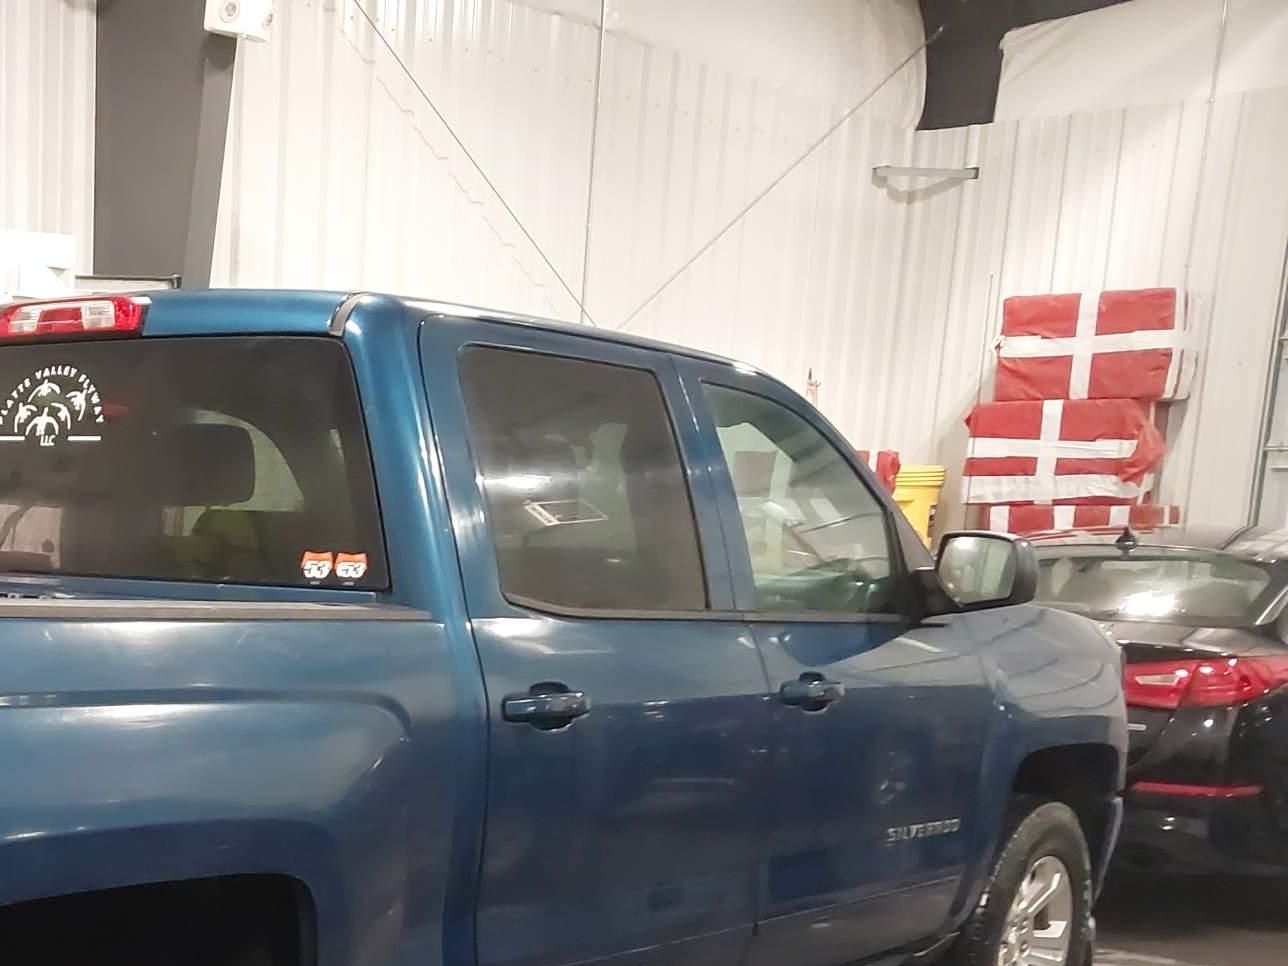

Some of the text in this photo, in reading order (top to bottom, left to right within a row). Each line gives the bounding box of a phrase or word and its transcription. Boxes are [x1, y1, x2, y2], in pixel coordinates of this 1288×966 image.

[34, 364, 78, 380] VALLEY
[78, 373, 105, 423] FLYWAY
[39, 434, 56, 447] LLC
